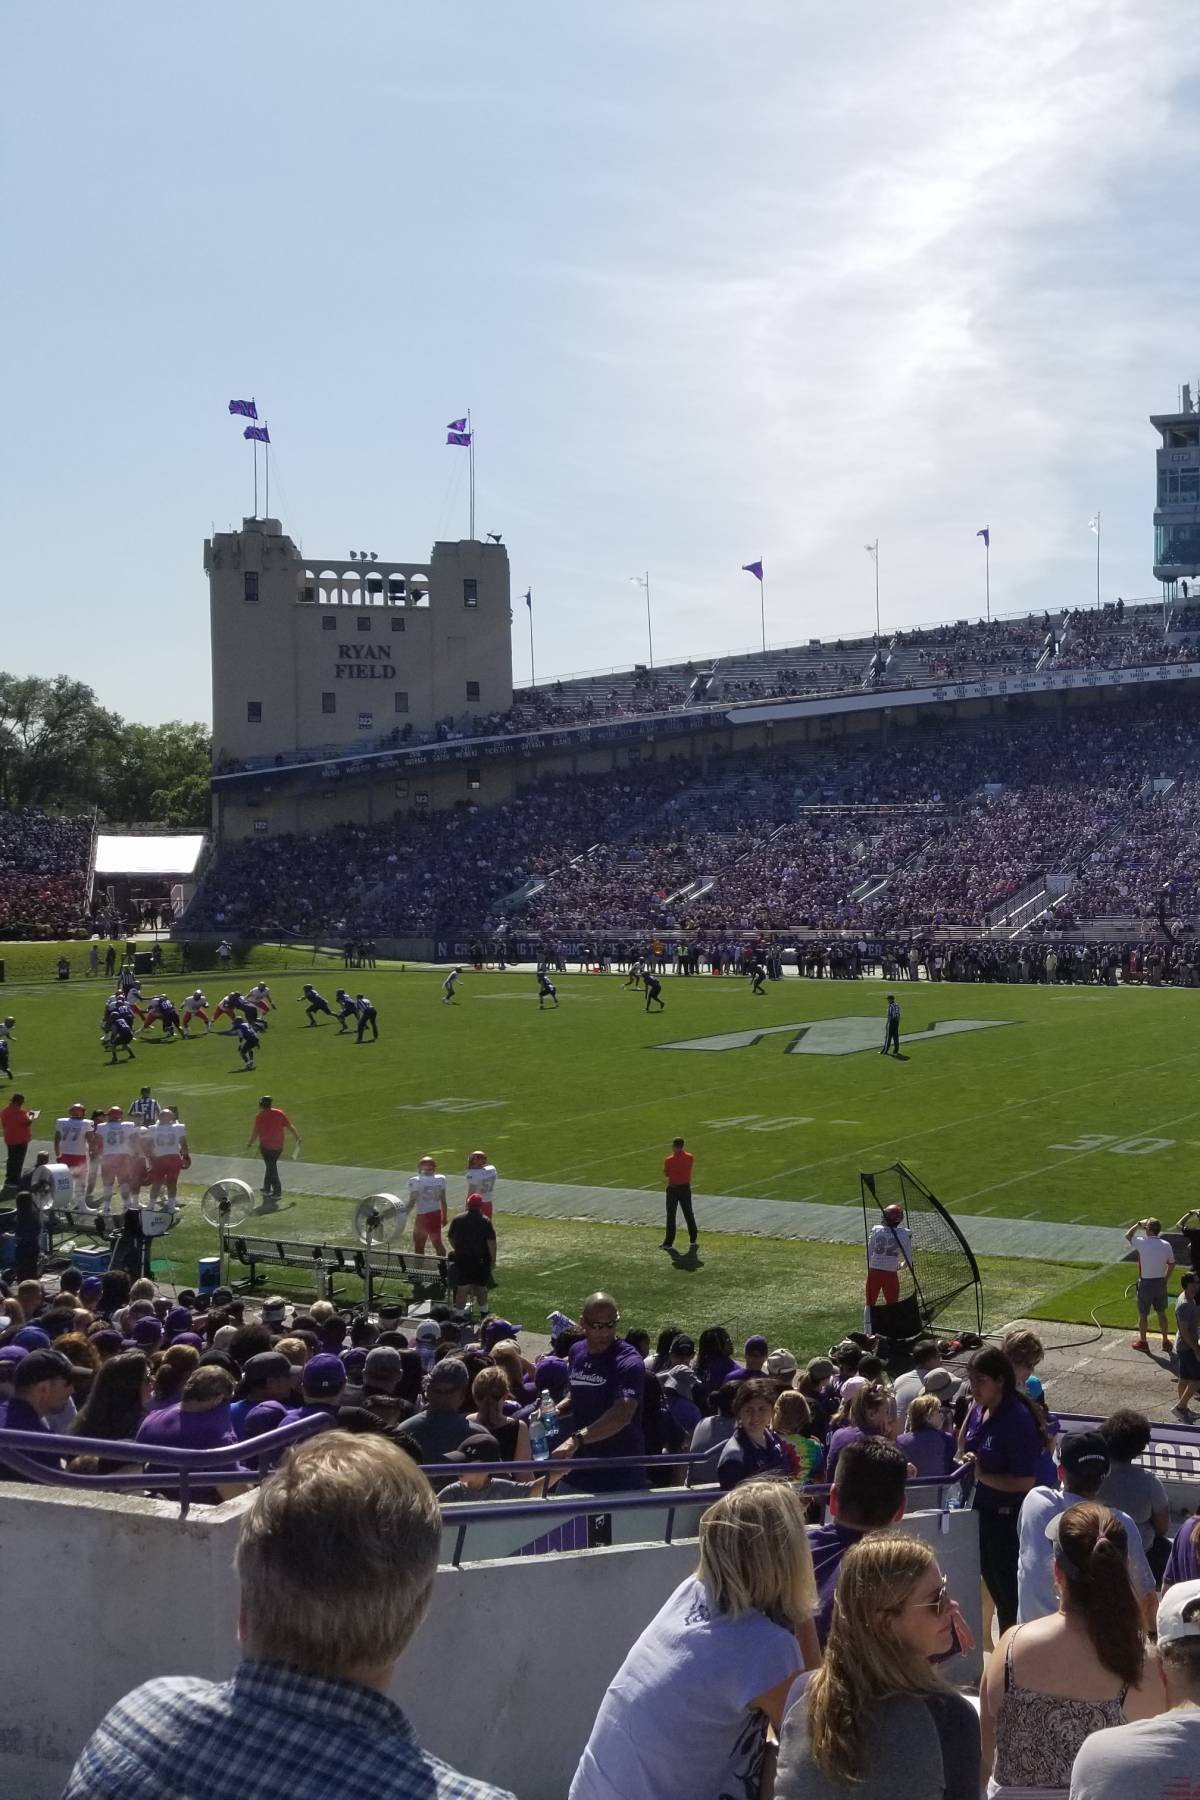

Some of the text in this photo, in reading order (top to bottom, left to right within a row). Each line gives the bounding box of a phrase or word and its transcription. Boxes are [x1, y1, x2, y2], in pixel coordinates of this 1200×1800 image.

[338, 645, 392, 660] RYAN
[335, 664, 397, 680] FIELD
[61, 1126, 80, 1142] 77
[1048, 1134, 1177, 1154] 30
[569, 1368, 606, 1384] Northwestern
